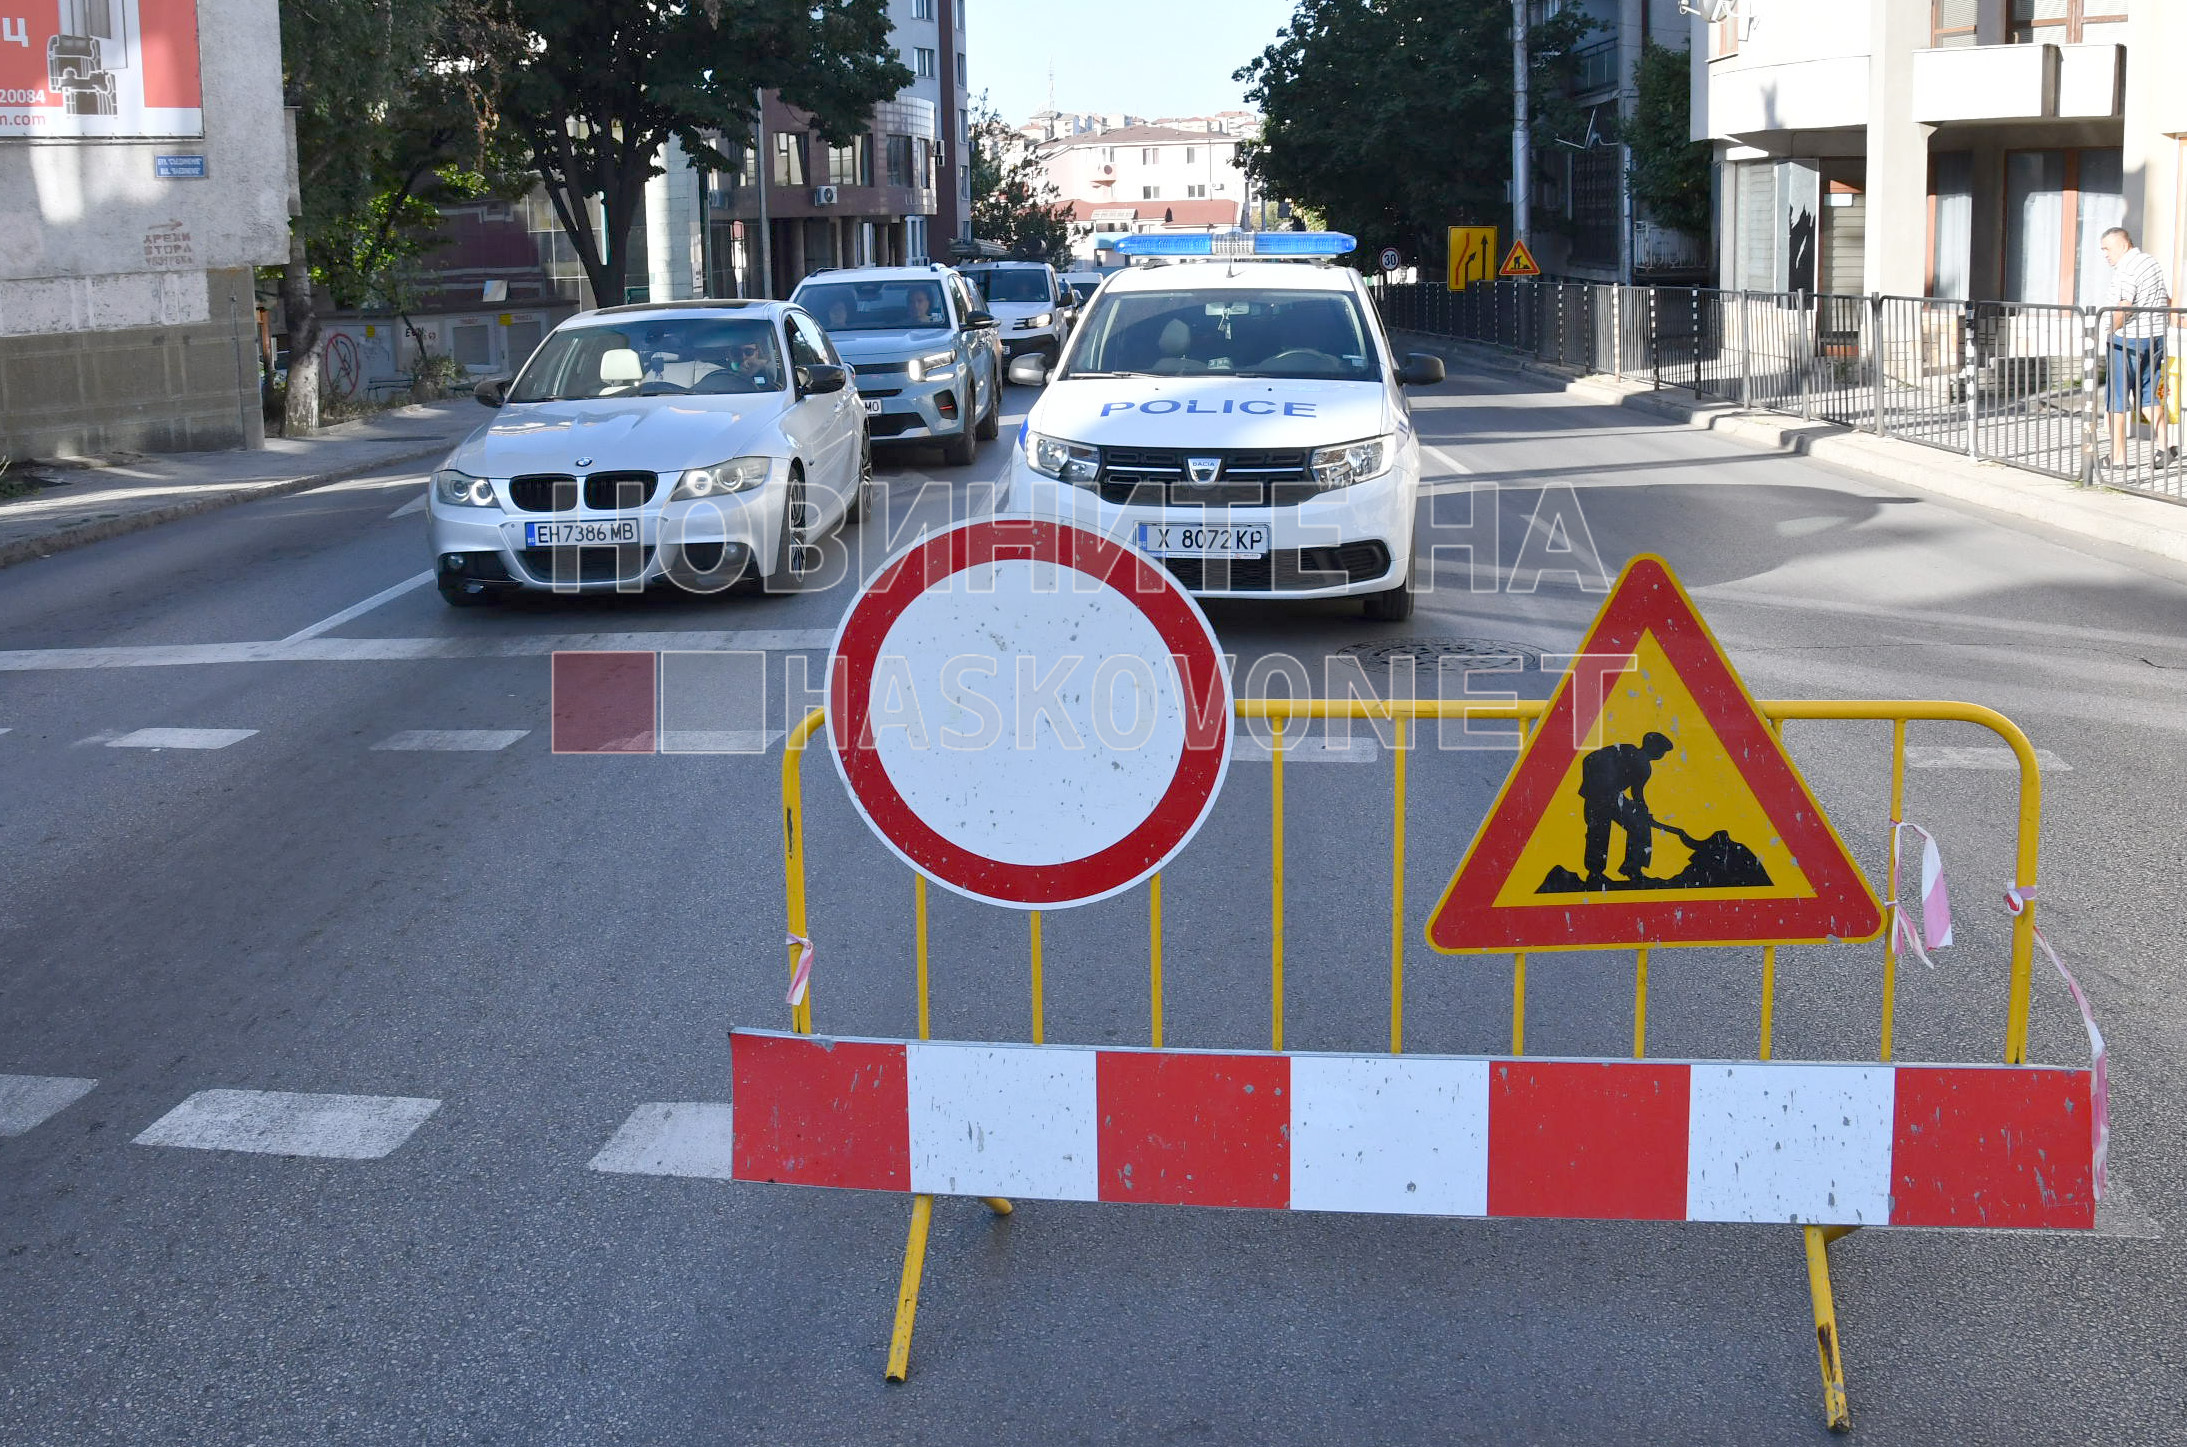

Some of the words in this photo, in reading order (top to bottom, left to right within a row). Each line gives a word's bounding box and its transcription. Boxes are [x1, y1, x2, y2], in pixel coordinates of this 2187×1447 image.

[1384, 254, 1397, 266] 30
[1100, 399, 1317, 418] POLICE
[563, 524, 607, 543] 7386
[1181, 529, 1232, 551] 8072
